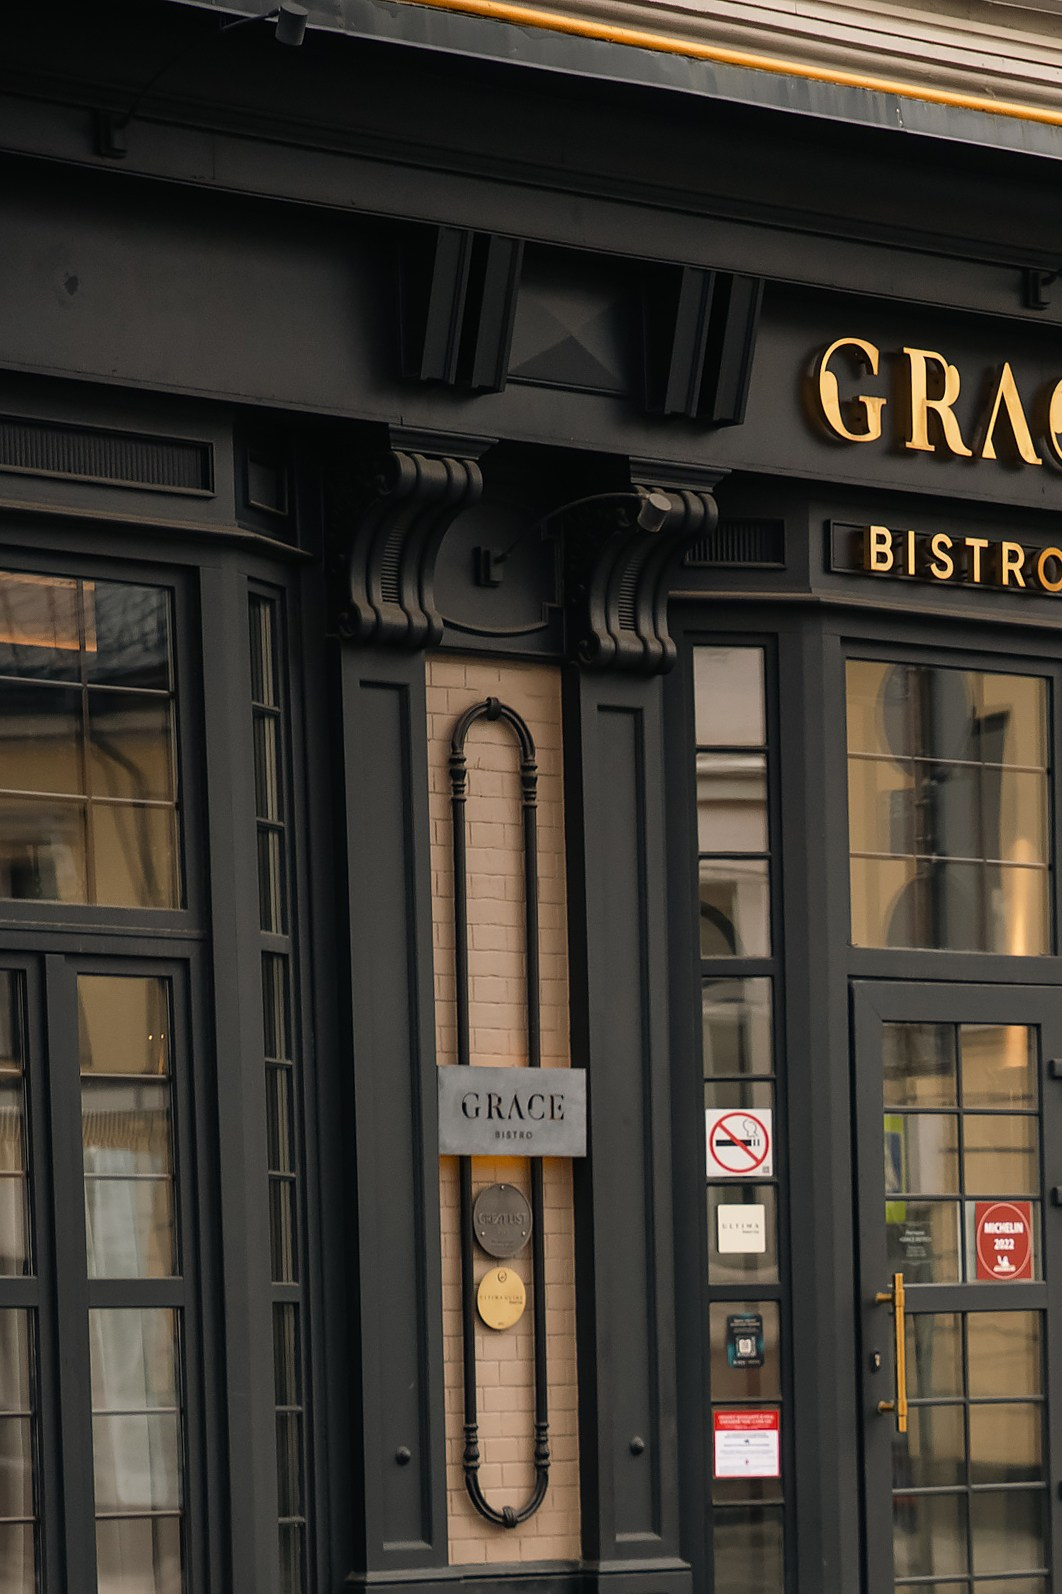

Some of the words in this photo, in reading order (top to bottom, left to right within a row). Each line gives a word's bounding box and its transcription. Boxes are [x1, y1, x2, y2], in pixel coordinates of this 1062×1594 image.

[461, 1091, 565, 1121] GRACE
[494, 1130, 533, 1140] BISTRO
[984, 1222, 1024, 1235] MICHELIN
[994, 1238, 1015, 1251] 2022
